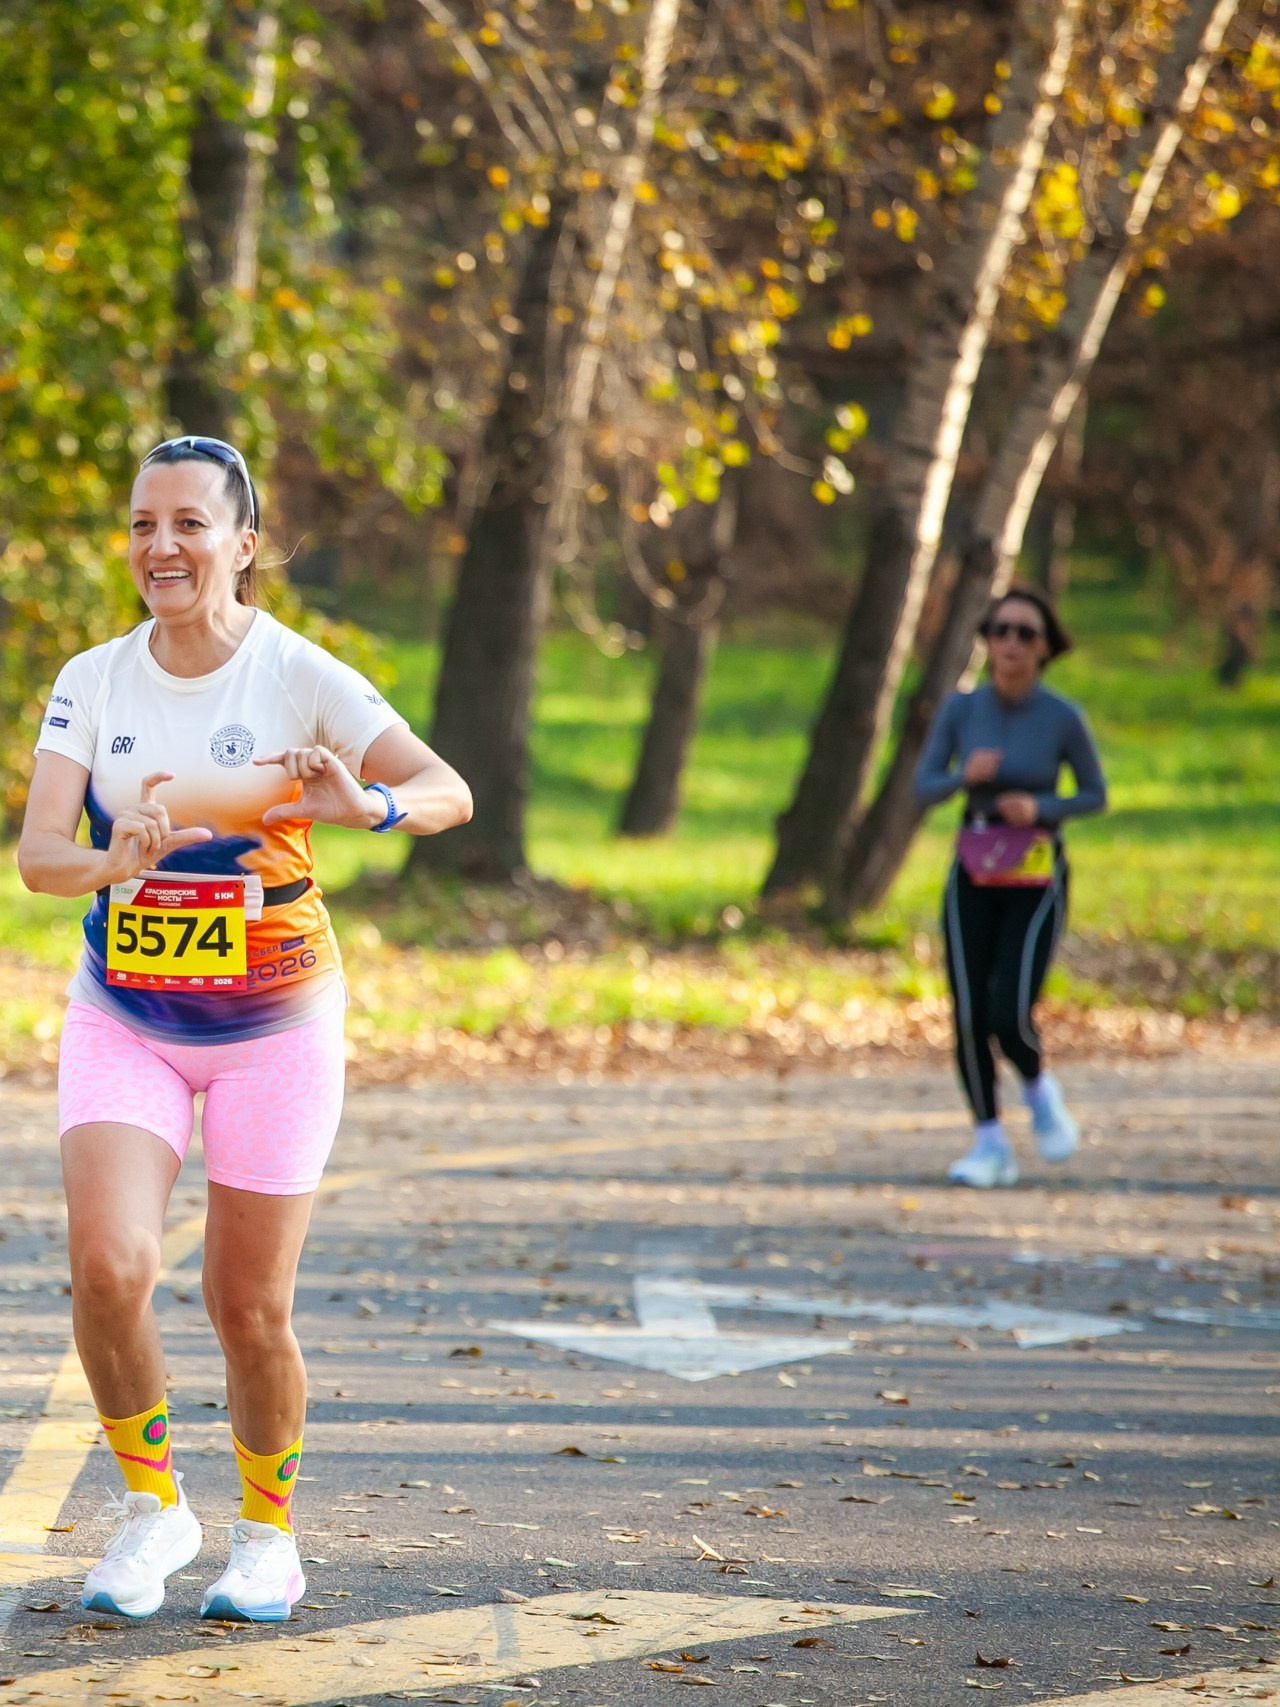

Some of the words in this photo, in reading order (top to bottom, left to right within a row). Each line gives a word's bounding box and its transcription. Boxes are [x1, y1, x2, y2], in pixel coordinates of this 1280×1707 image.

[144, 888, 197, 897] КРАСНОЯРСКИЕ
[214, 892, 220, 900] 5
[116, 911, 234, 958] 5574
[213, 978, 233, 986] 2026
